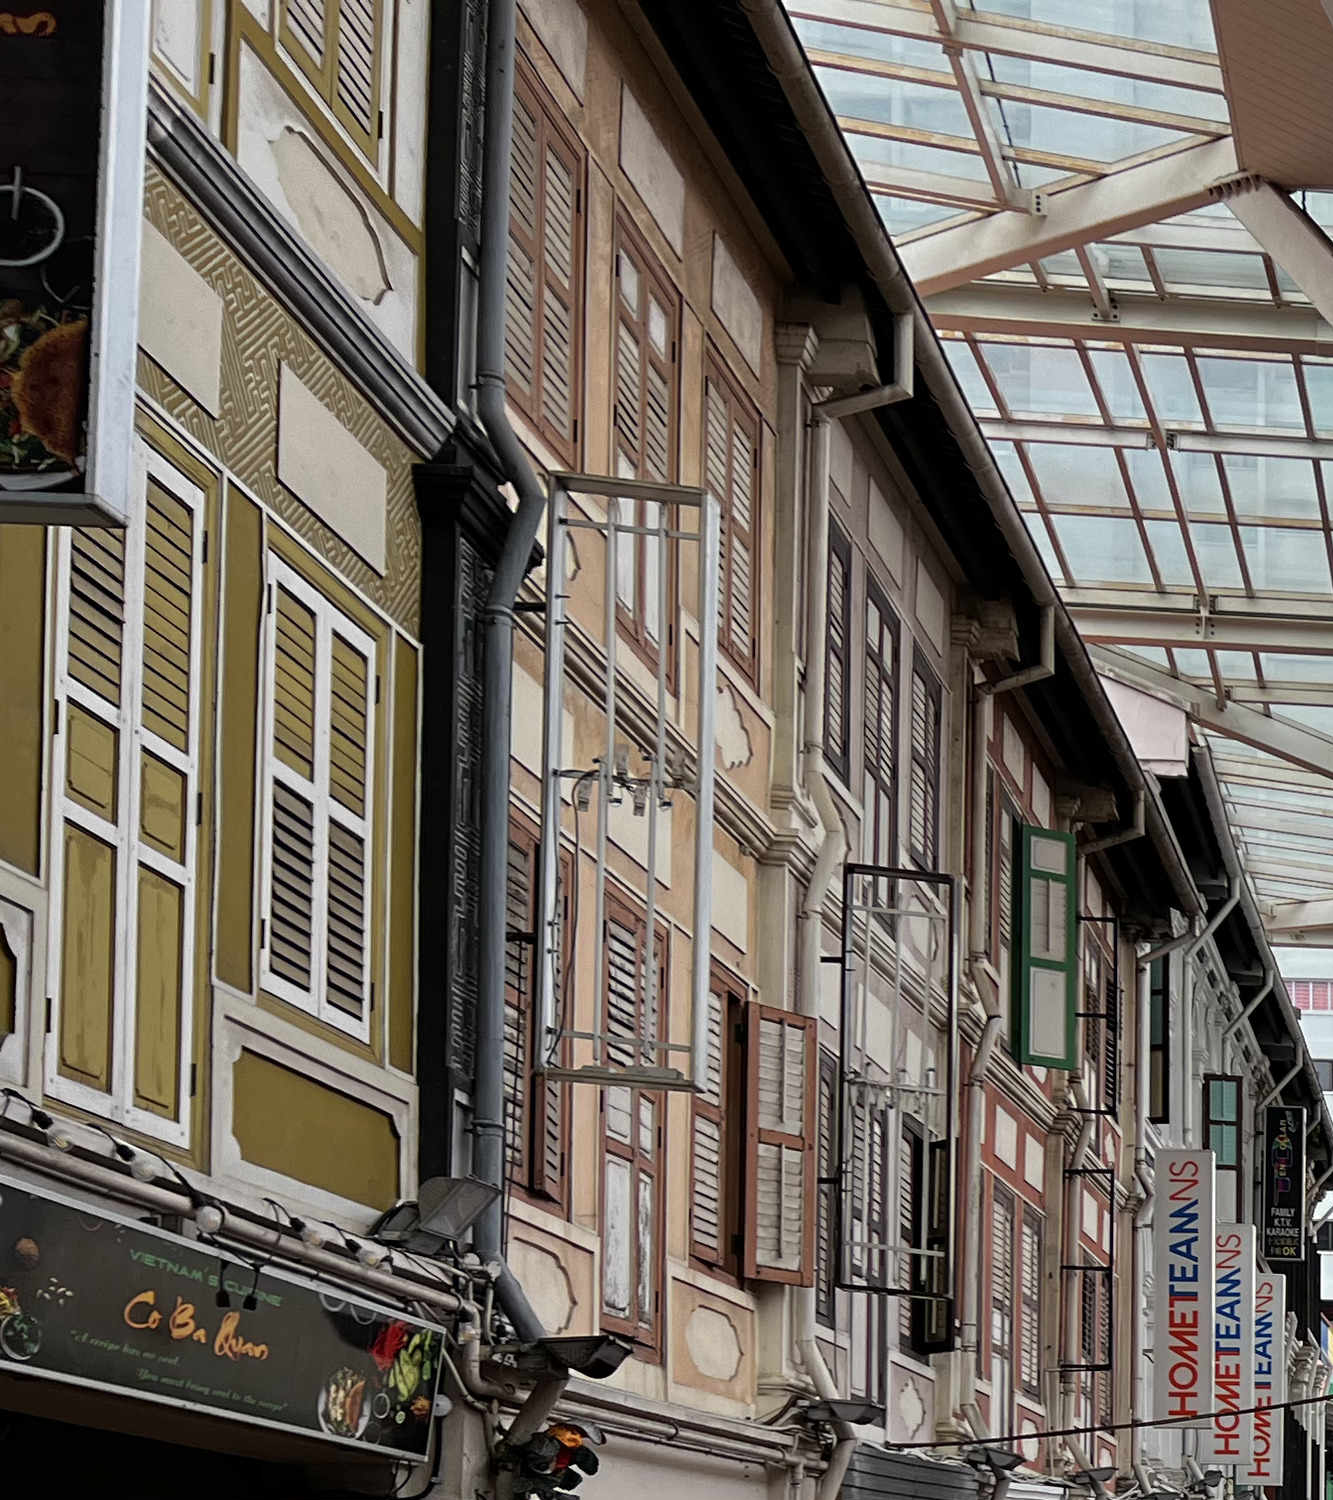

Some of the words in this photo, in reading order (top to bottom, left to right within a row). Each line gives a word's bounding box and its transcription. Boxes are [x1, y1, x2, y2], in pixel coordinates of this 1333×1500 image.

[1266, 1228, 1299, 1237] KARAOKE
[1270, 1207, 1296, 1217] FAMILY
[1168, 1160, 1199, 1417] HOMETEAMNS
[1213, 1233, 1242, 1456] HOMETEAMNS
